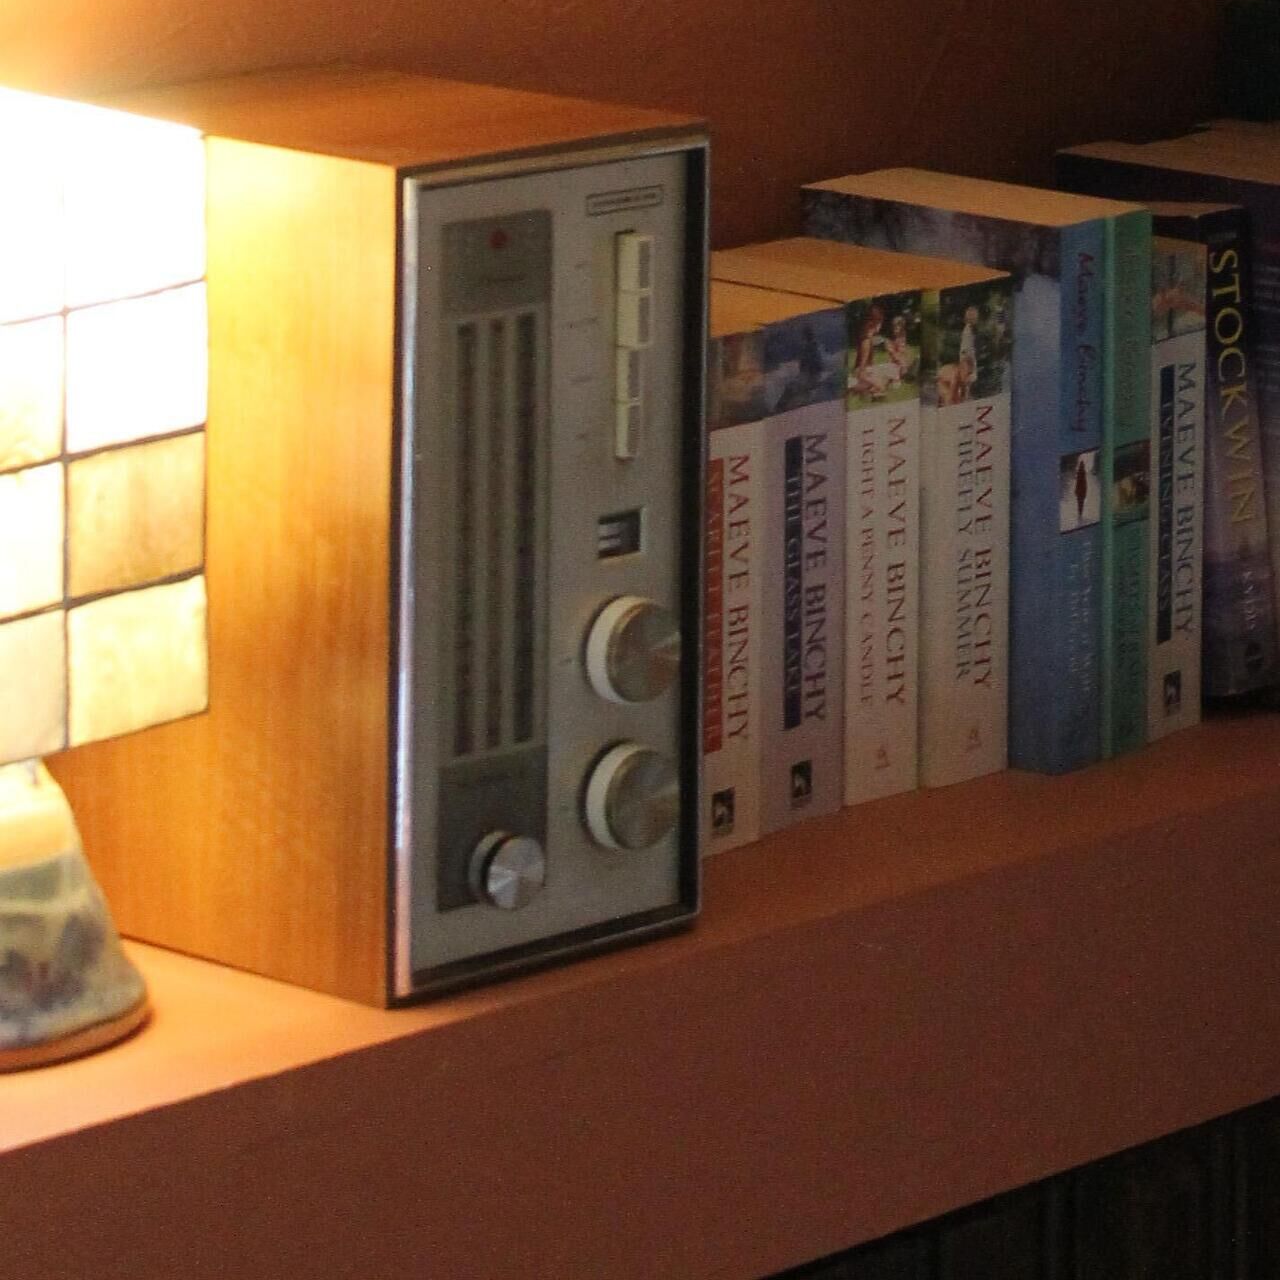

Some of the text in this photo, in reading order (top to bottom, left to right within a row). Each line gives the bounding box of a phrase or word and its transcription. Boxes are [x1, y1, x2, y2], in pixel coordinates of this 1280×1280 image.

[1174, 362, 1197, 635] MAEVE BINCHY
[1209, 248, 1254, 524] STOCKWIN
[727, 454, 750, 740] MAEVE BINCHY
[803, 432, 828, 722] MAEVE BINCHY
[861, 527, 875, 603] PENNY
[885, 416, 907, 708] MAEVE BINCHY
[973, 403, 995, 691] MAEVE BINCHY
